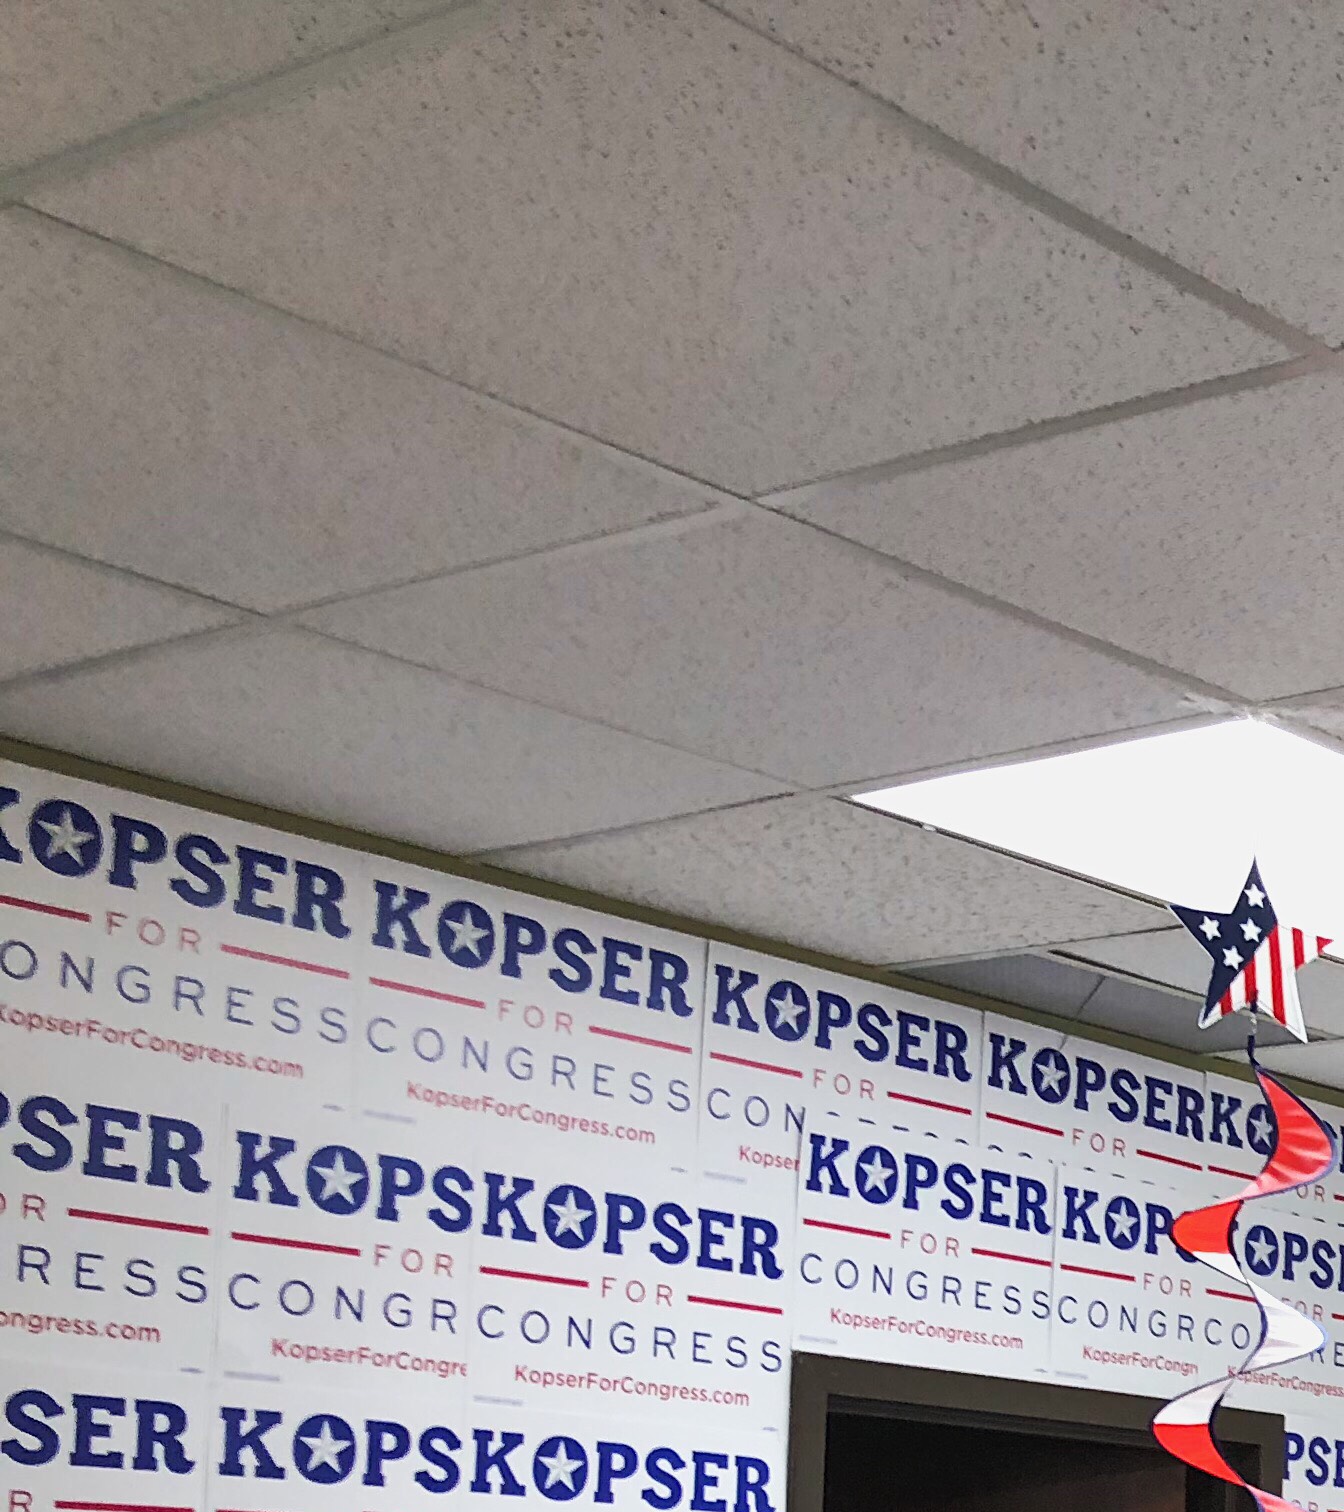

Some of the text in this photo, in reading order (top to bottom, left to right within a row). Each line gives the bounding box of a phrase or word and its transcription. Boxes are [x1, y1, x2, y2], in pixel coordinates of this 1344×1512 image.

[105, 911, 202, 955] FOR
[371, 879, 693, 1020] KOPSER
[499, 999, 574, 1036] FOR
[711, 963, 973, 1082] KOPSER
[367, 1015, 691, 1114] CONGRESS
[812, 1069, 875, 1100] FOR
[986, 1031, 1205, 1157] KOPSER
[0, 1090, 212, 1194] SER
[406, 1081, 657, 1146] KopserForCongress.com
[1073, 1128, 1126, 1158] FOR
[805, 1132, 1053, 1237] KOPSER
[481, 1171, 784, 1280] KOPSER
[900, 1230, 960, 1258] FOR
[1062, 1185, 1198, 1263] KOP
[374, 1245, 454, 1278] FOR
[601, 1277, 673, 1307] FOR
[800, 1253, 1052, 1320] CONGRESS
[1143, 1272, 1192, 1297] FOR
[476, 1304, 783, 1373] CONGRESS
[829, 1308, 1024, 1351] KopserForCongress.com
[515, 1364, 750, 1408] KopserForCongress.com
